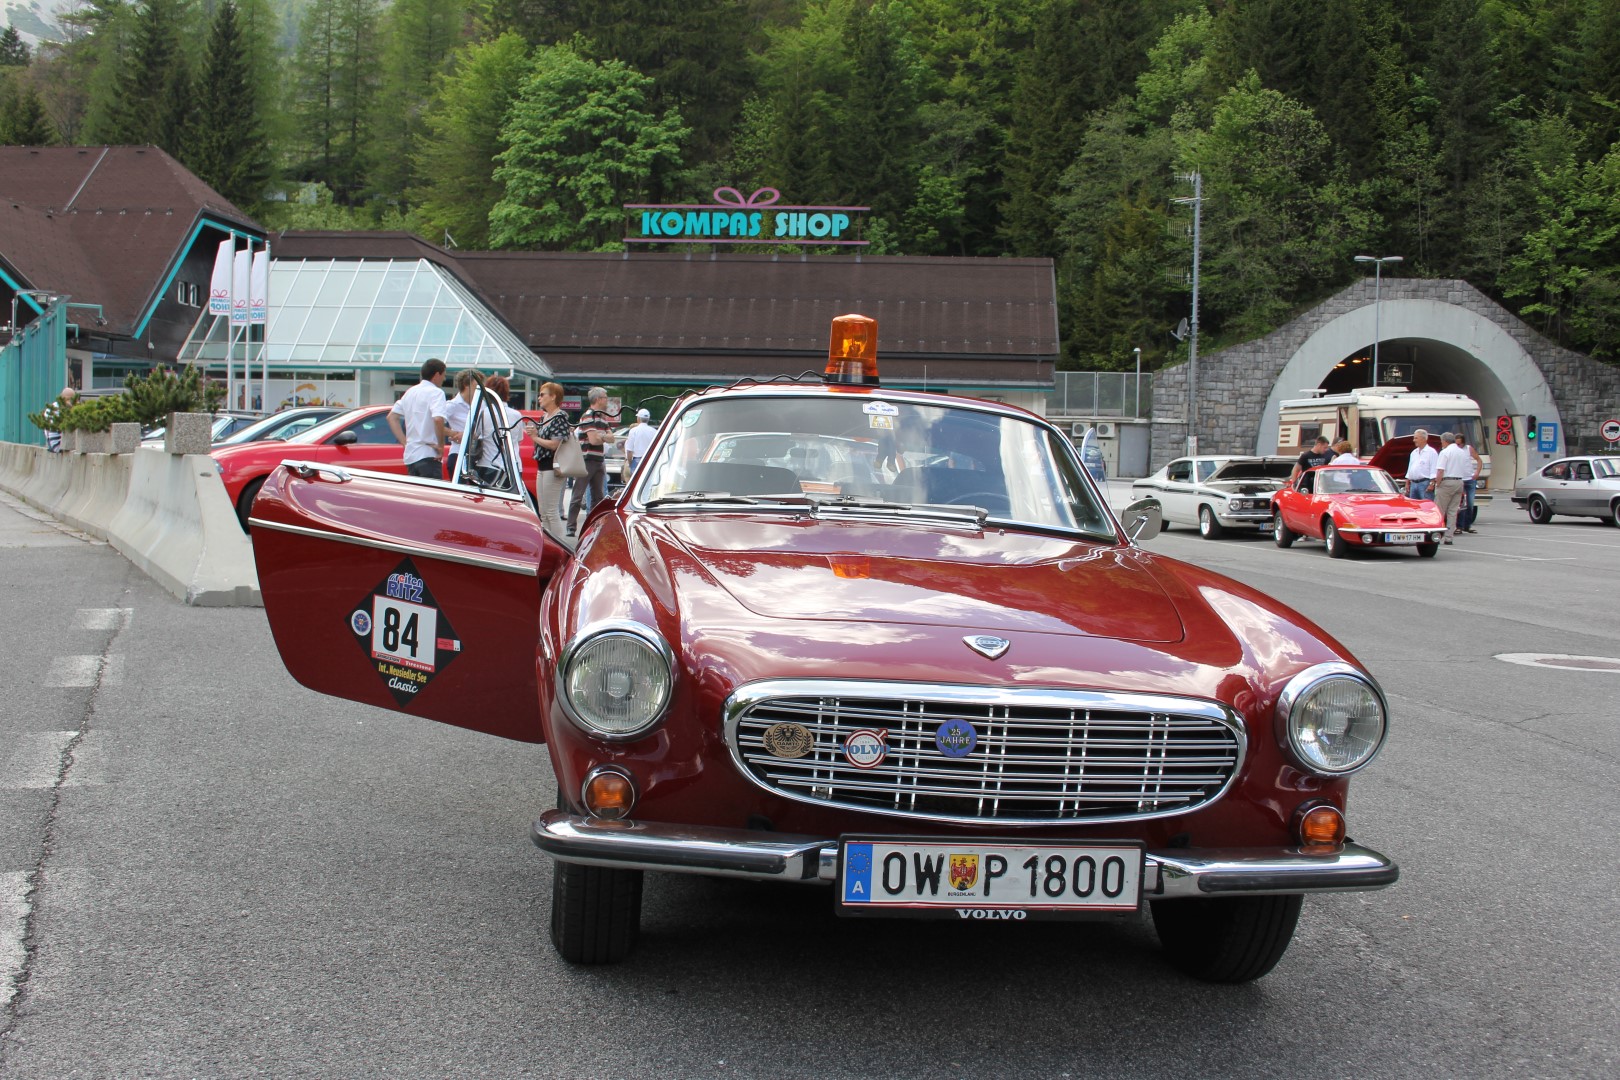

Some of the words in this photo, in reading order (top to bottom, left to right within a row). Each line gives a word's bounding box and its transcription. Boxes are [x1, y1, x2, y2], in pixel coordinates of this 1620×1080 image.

[642, 211, 762, 236] KOMPAS
[774, 212, 850, 237] SHOP
[387, 582, 423, 602] RITZ
[383, 607, 418, 657] 84
[378, 661, 389, 674] Int.
[389, 664, 417, 682] Neusiedler
[417, 672, 427, 684] See
[405, 660, 432, 671] Firestone
[388, 677, 418, 694] Classic
[840, 744, 891, 755] VOLVO
[940, 735, 971, 746] JAHRE
[851, 880, 864, 894] A
[883, 852, 945, 896] OW
[983, 853, 1008, 897] P
[1022, 854, 1126, 899] 1800
[955, 908, 1027, 920] VOLVO
